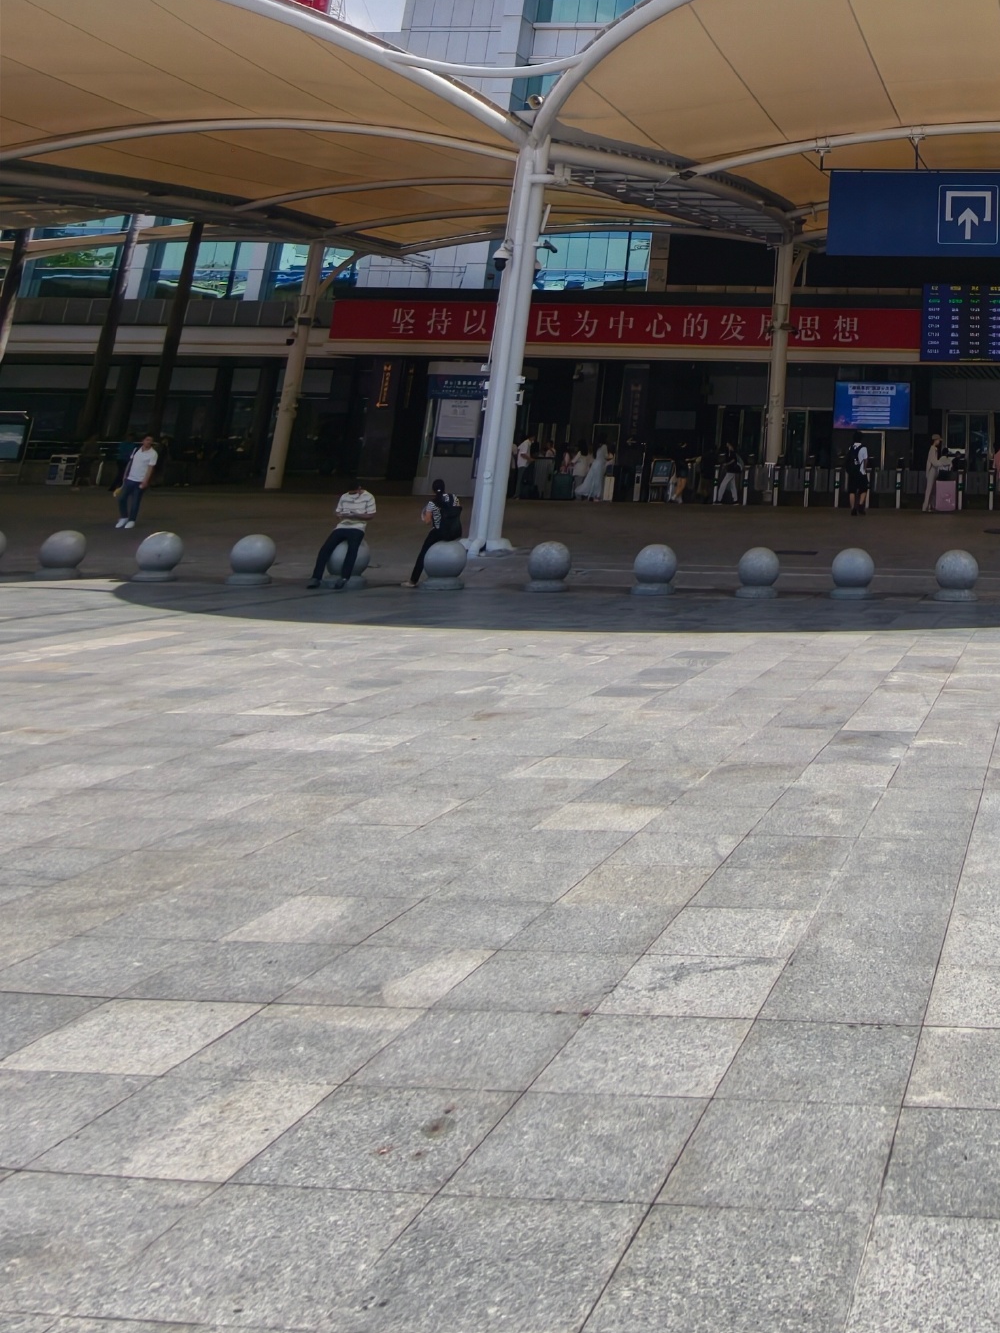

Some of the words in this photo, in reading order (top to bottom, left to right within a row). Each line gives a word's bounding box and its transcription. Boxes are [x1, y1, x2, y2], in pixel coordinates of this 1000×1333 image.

[388, 307, 860, 343] 坚持以民为中心的发思想
